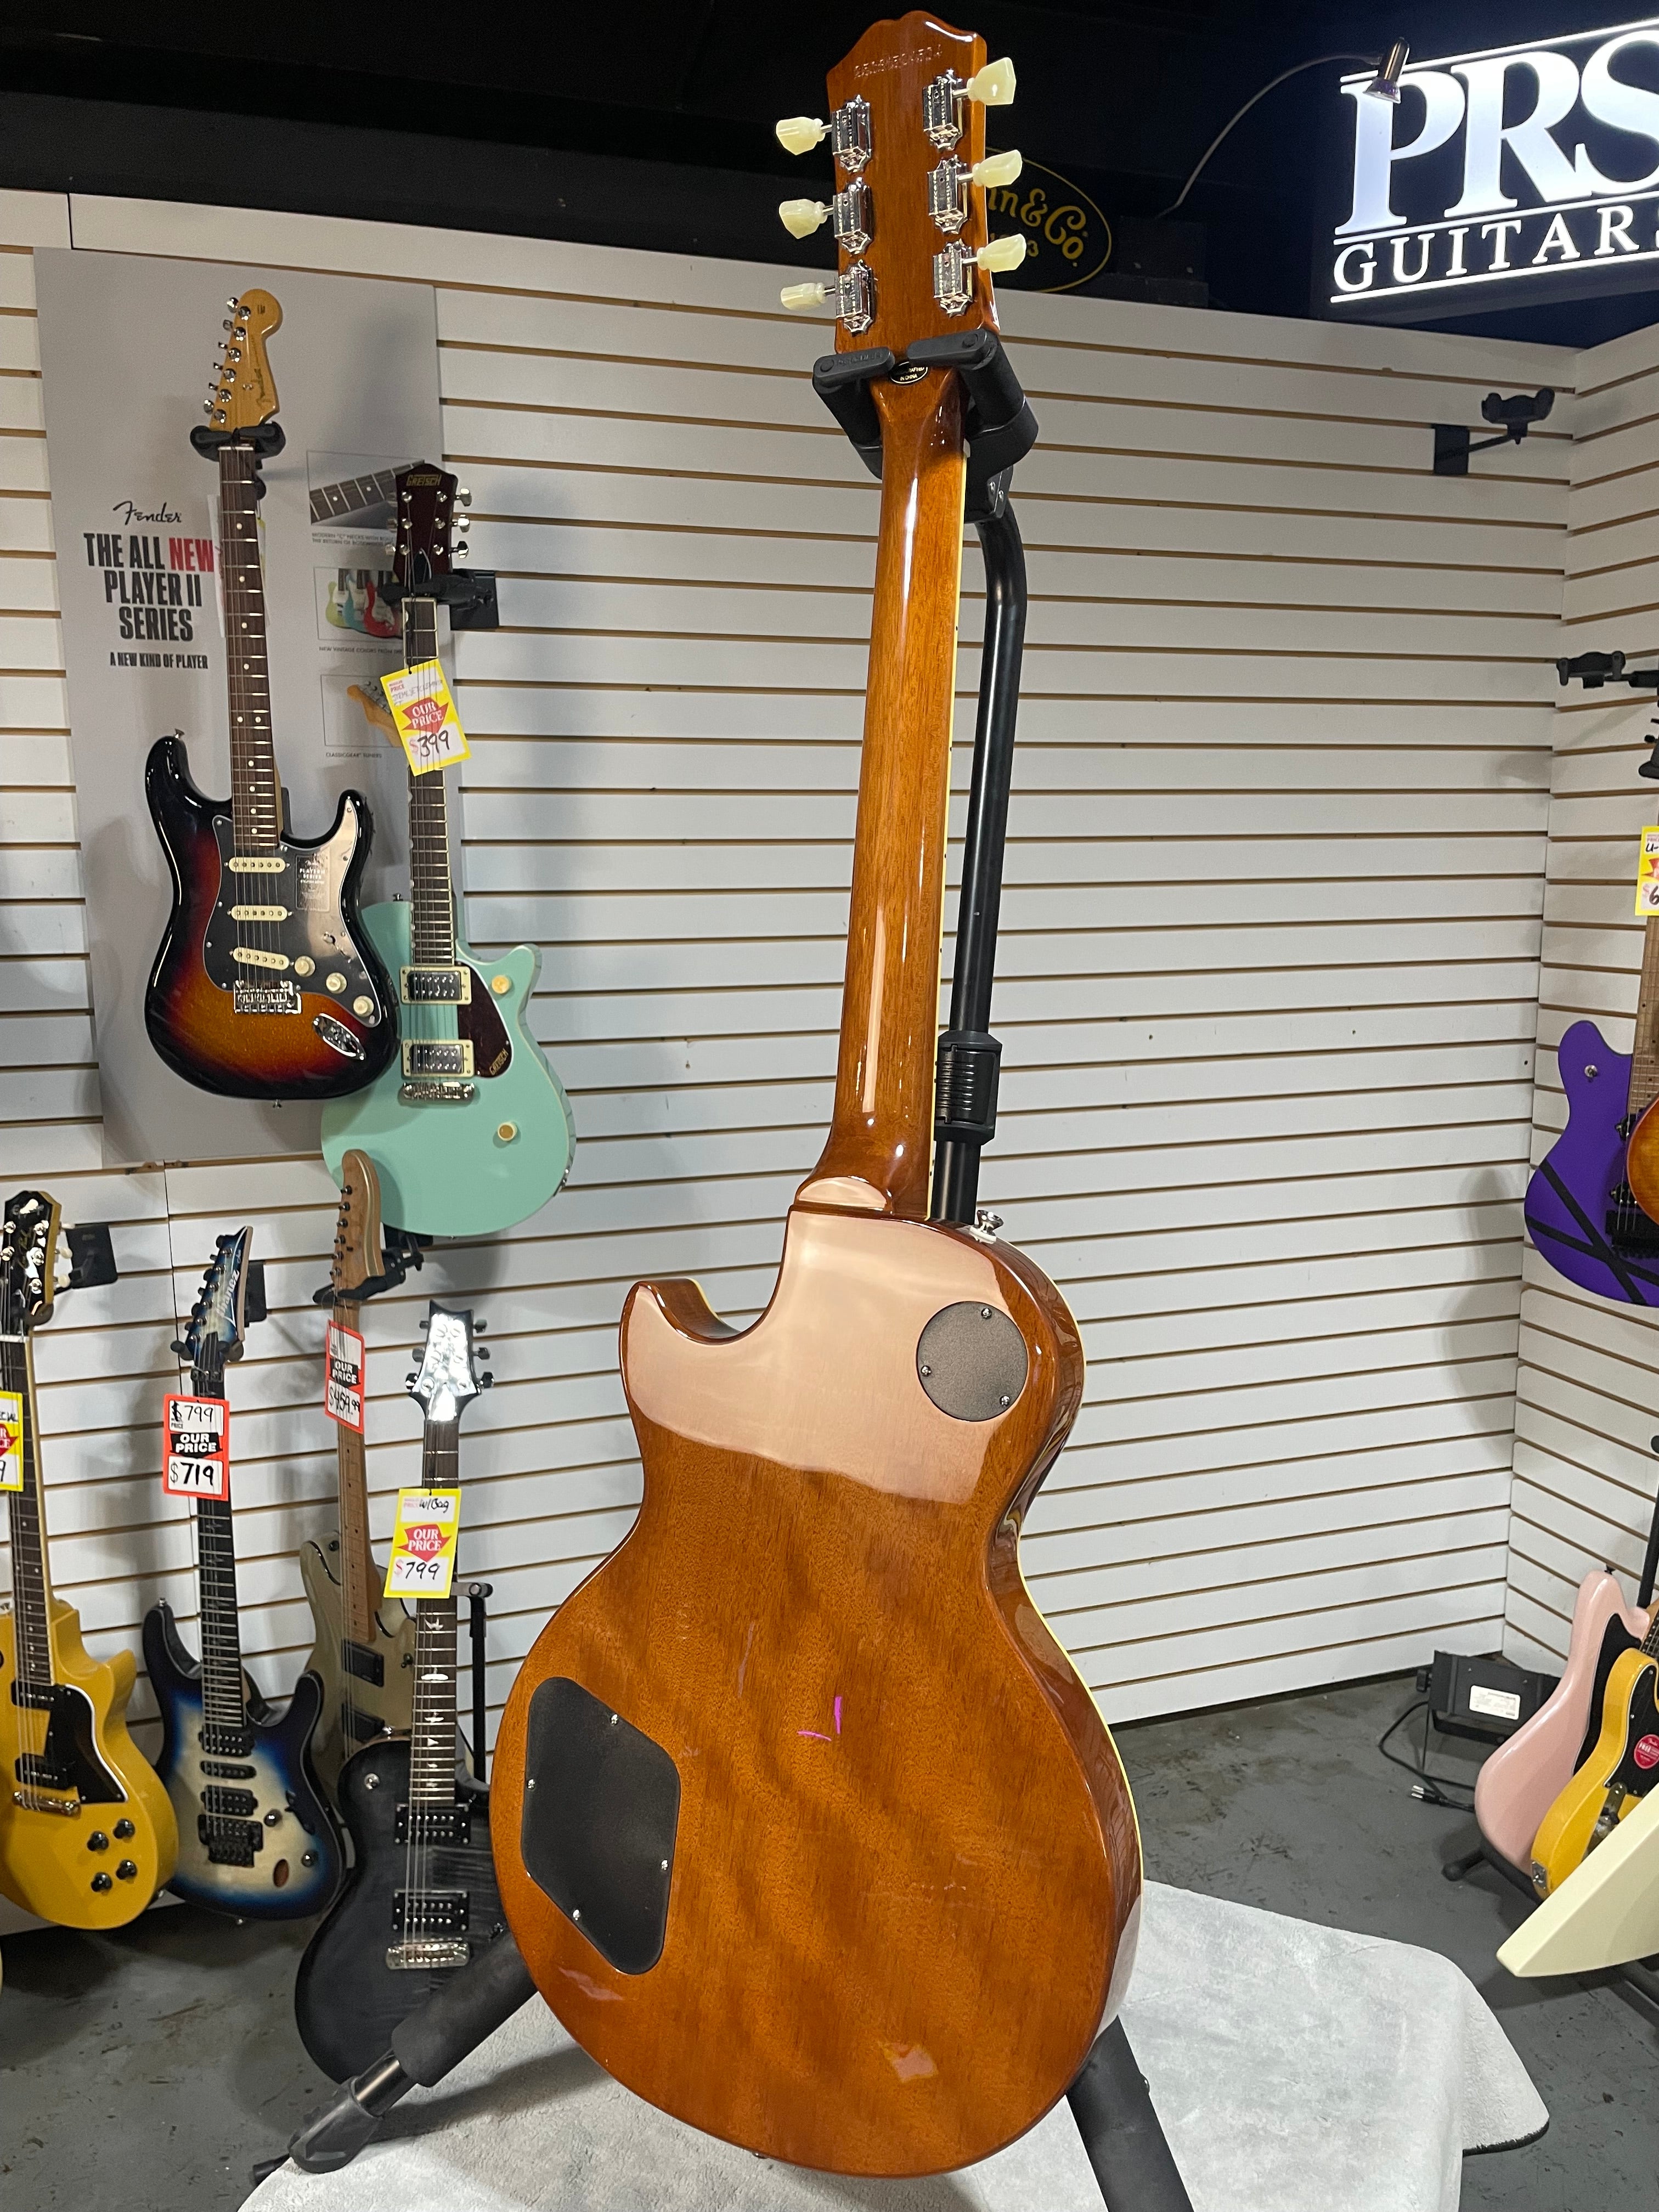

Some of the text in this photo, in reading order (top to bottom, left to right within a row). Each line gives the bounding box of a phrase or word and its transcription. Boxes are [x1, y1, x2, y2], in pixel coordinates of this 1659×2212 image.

[1335, 30, 1659, 236] PRS
[1334, 205, 1659, 292] GUITAR
[112, 500, 182, 526] Fender
[83, 533, 215, 572] THE ALL NEW
[104, 569, 202, 607] PLAYER II
[119, 606, 194, 642] SERIES
[110, 652, 208, 669] A NEW KIND OF PLAYER
[412, 701, 437, 717] OUR
[411, 710, 444, 729] PRICE
[216, 1269, 240, 1316] Ibanez
[335, 1361, 353, 1373] OUR
[332, 1370, 358, 1384] PRICE
[175, 1443, 217, 1453] PRICE
[180, 1433, 210, 1444] OUR
[170, 1461, 214, 1486] $719
[413, 1528, 439, 1540] OUR
[408, 1540, 442, 1552] PRICE
[394, 1560, 440, 1580] $799
